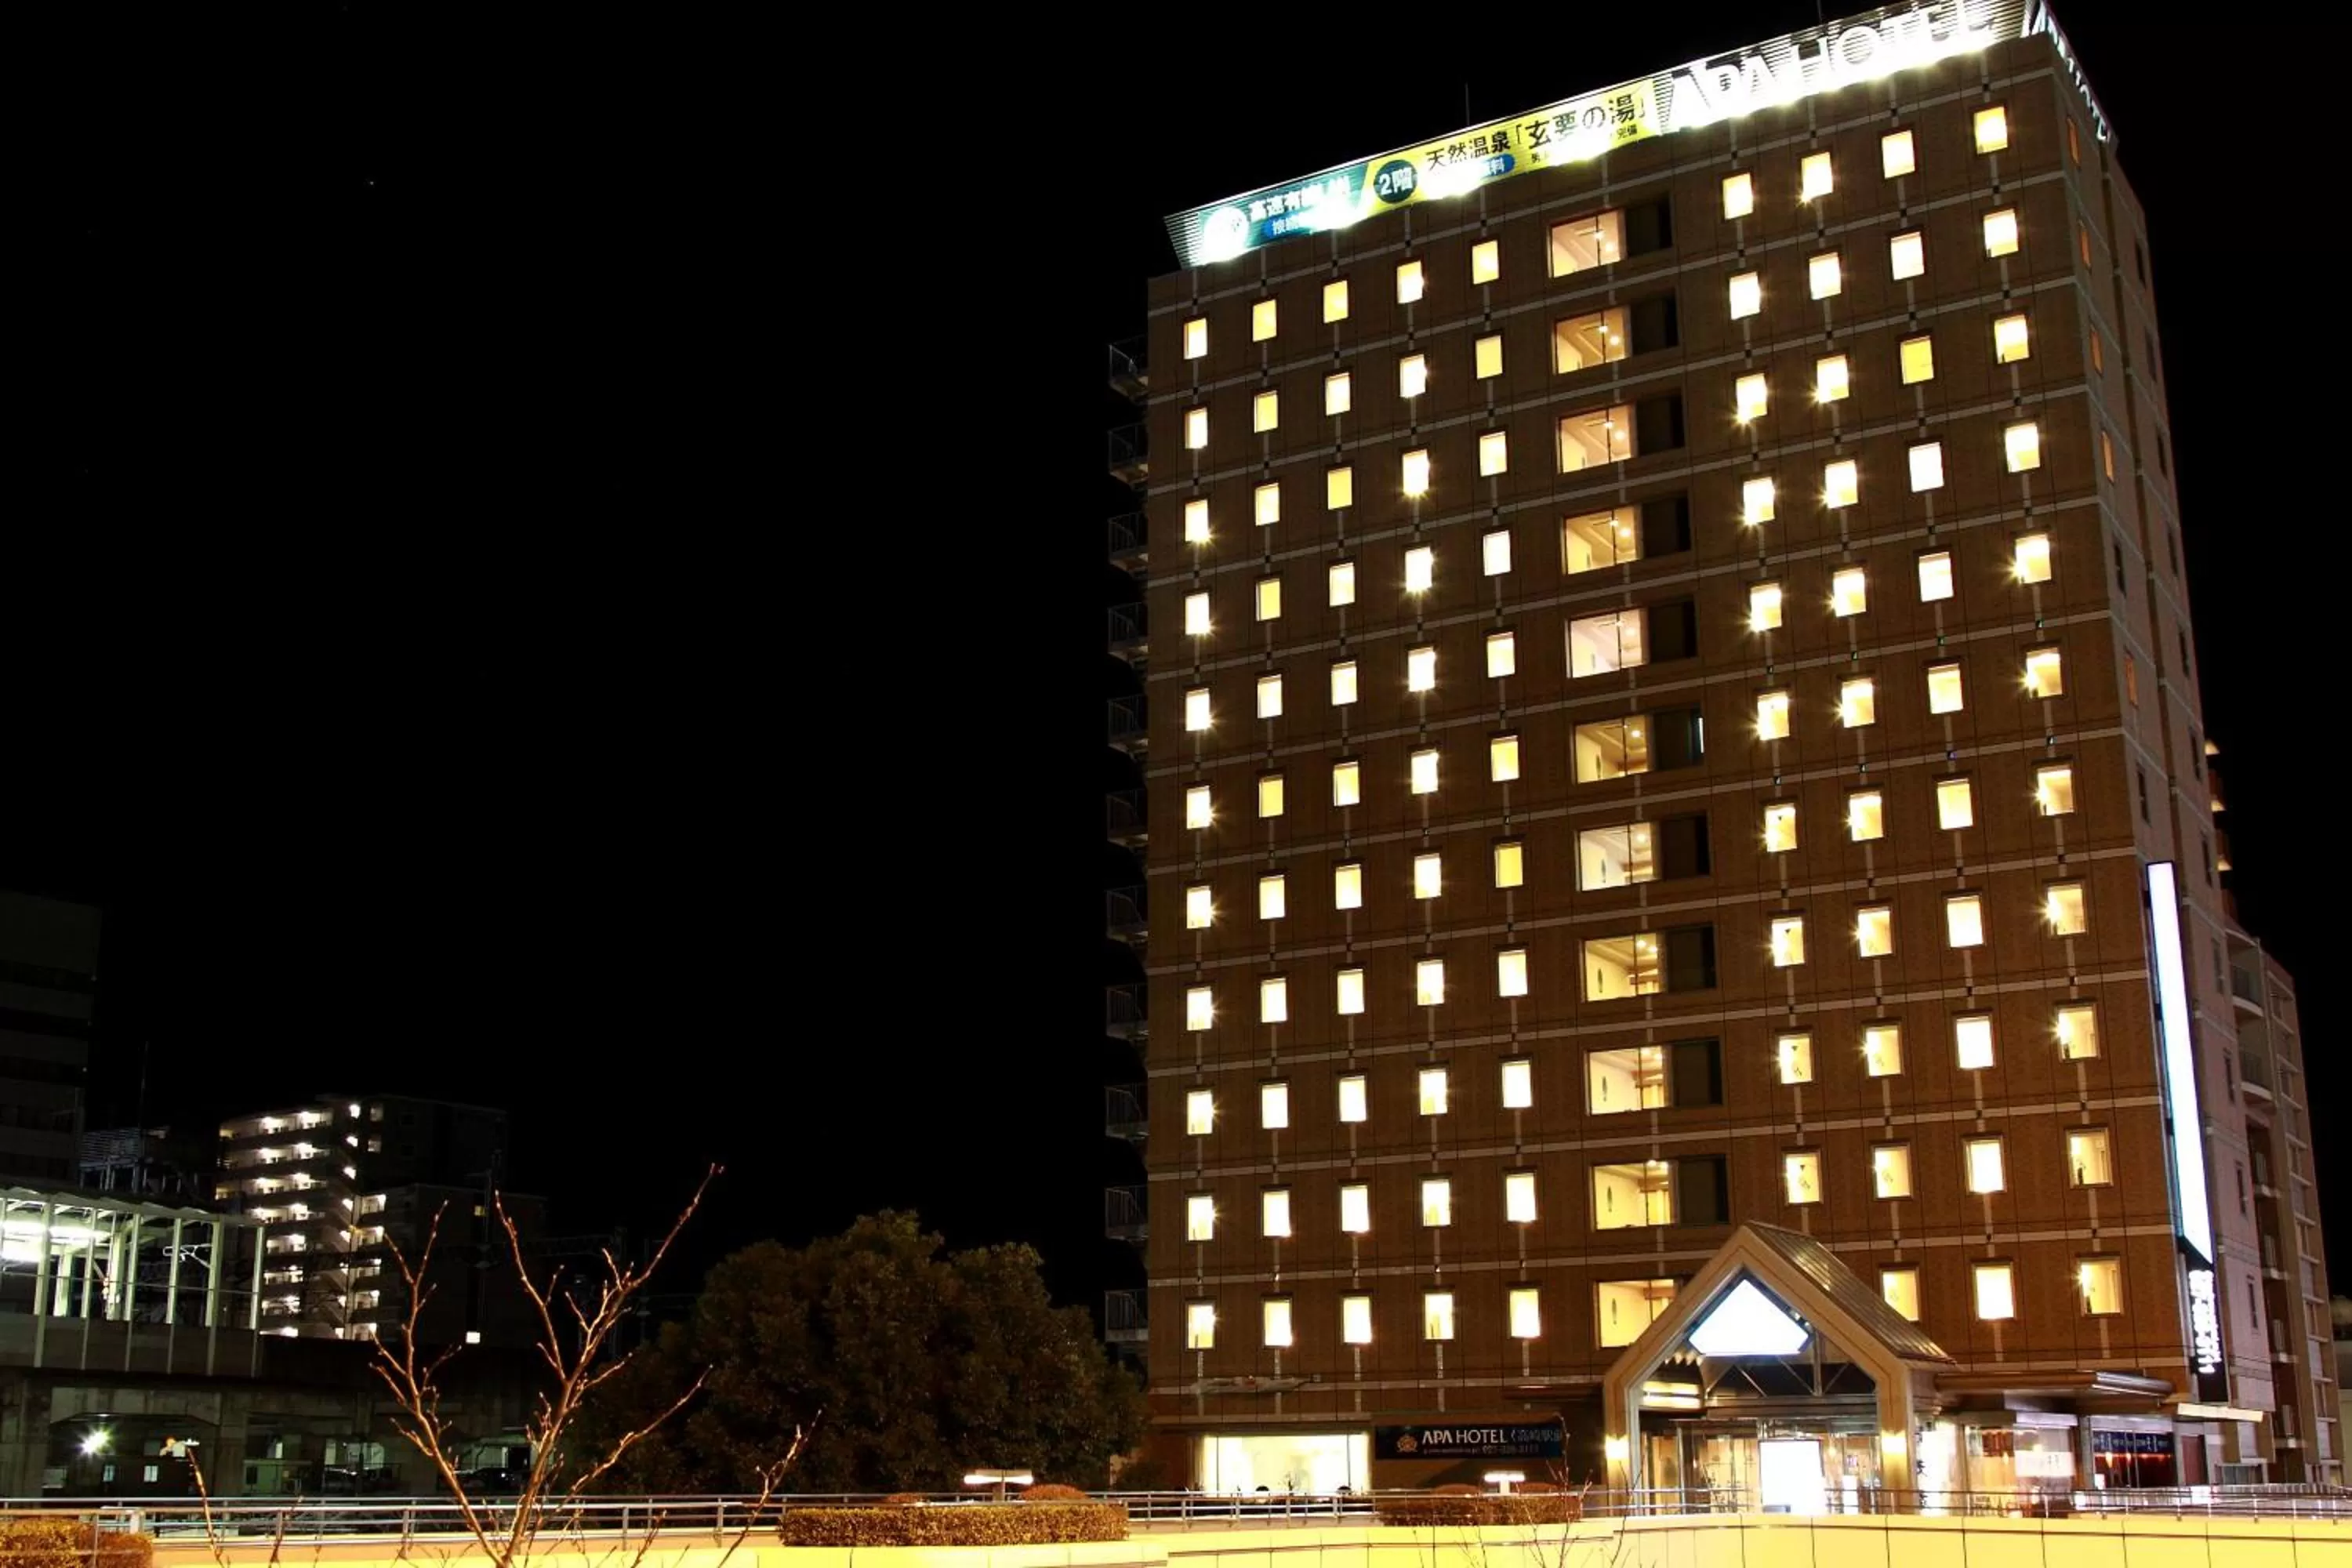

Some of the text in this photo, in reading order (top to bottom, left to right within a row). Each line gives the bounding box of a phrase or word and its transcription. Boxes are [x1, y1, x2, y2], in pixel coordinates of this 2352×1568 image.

[1378, 166, 1413, 196] 2階
[1422, 1429, 1454, 1445] APA
[1456, 1429, 1508, 1444] HOTEL
